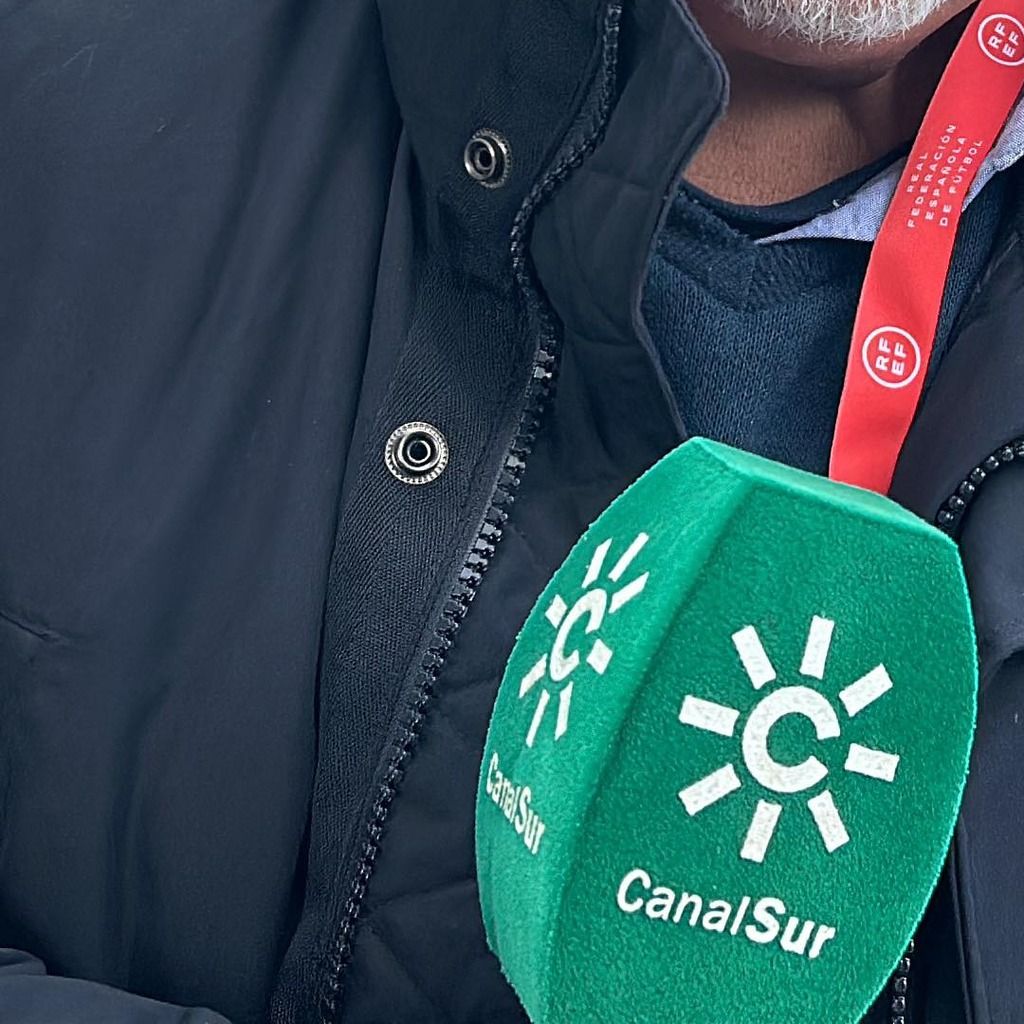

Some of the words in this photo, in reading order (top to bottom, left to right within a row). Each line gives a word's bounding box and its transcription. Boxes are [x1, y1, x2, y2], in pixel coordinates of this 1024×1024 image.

[906, 152, 929, 194] REAL
[907, 124, 957, 228] FEDERACIÓN
[939, 204, 953, 227] DE
[485, 752, 547, 855] CanalSur
[616, 867, 837, 960] CanalSur
